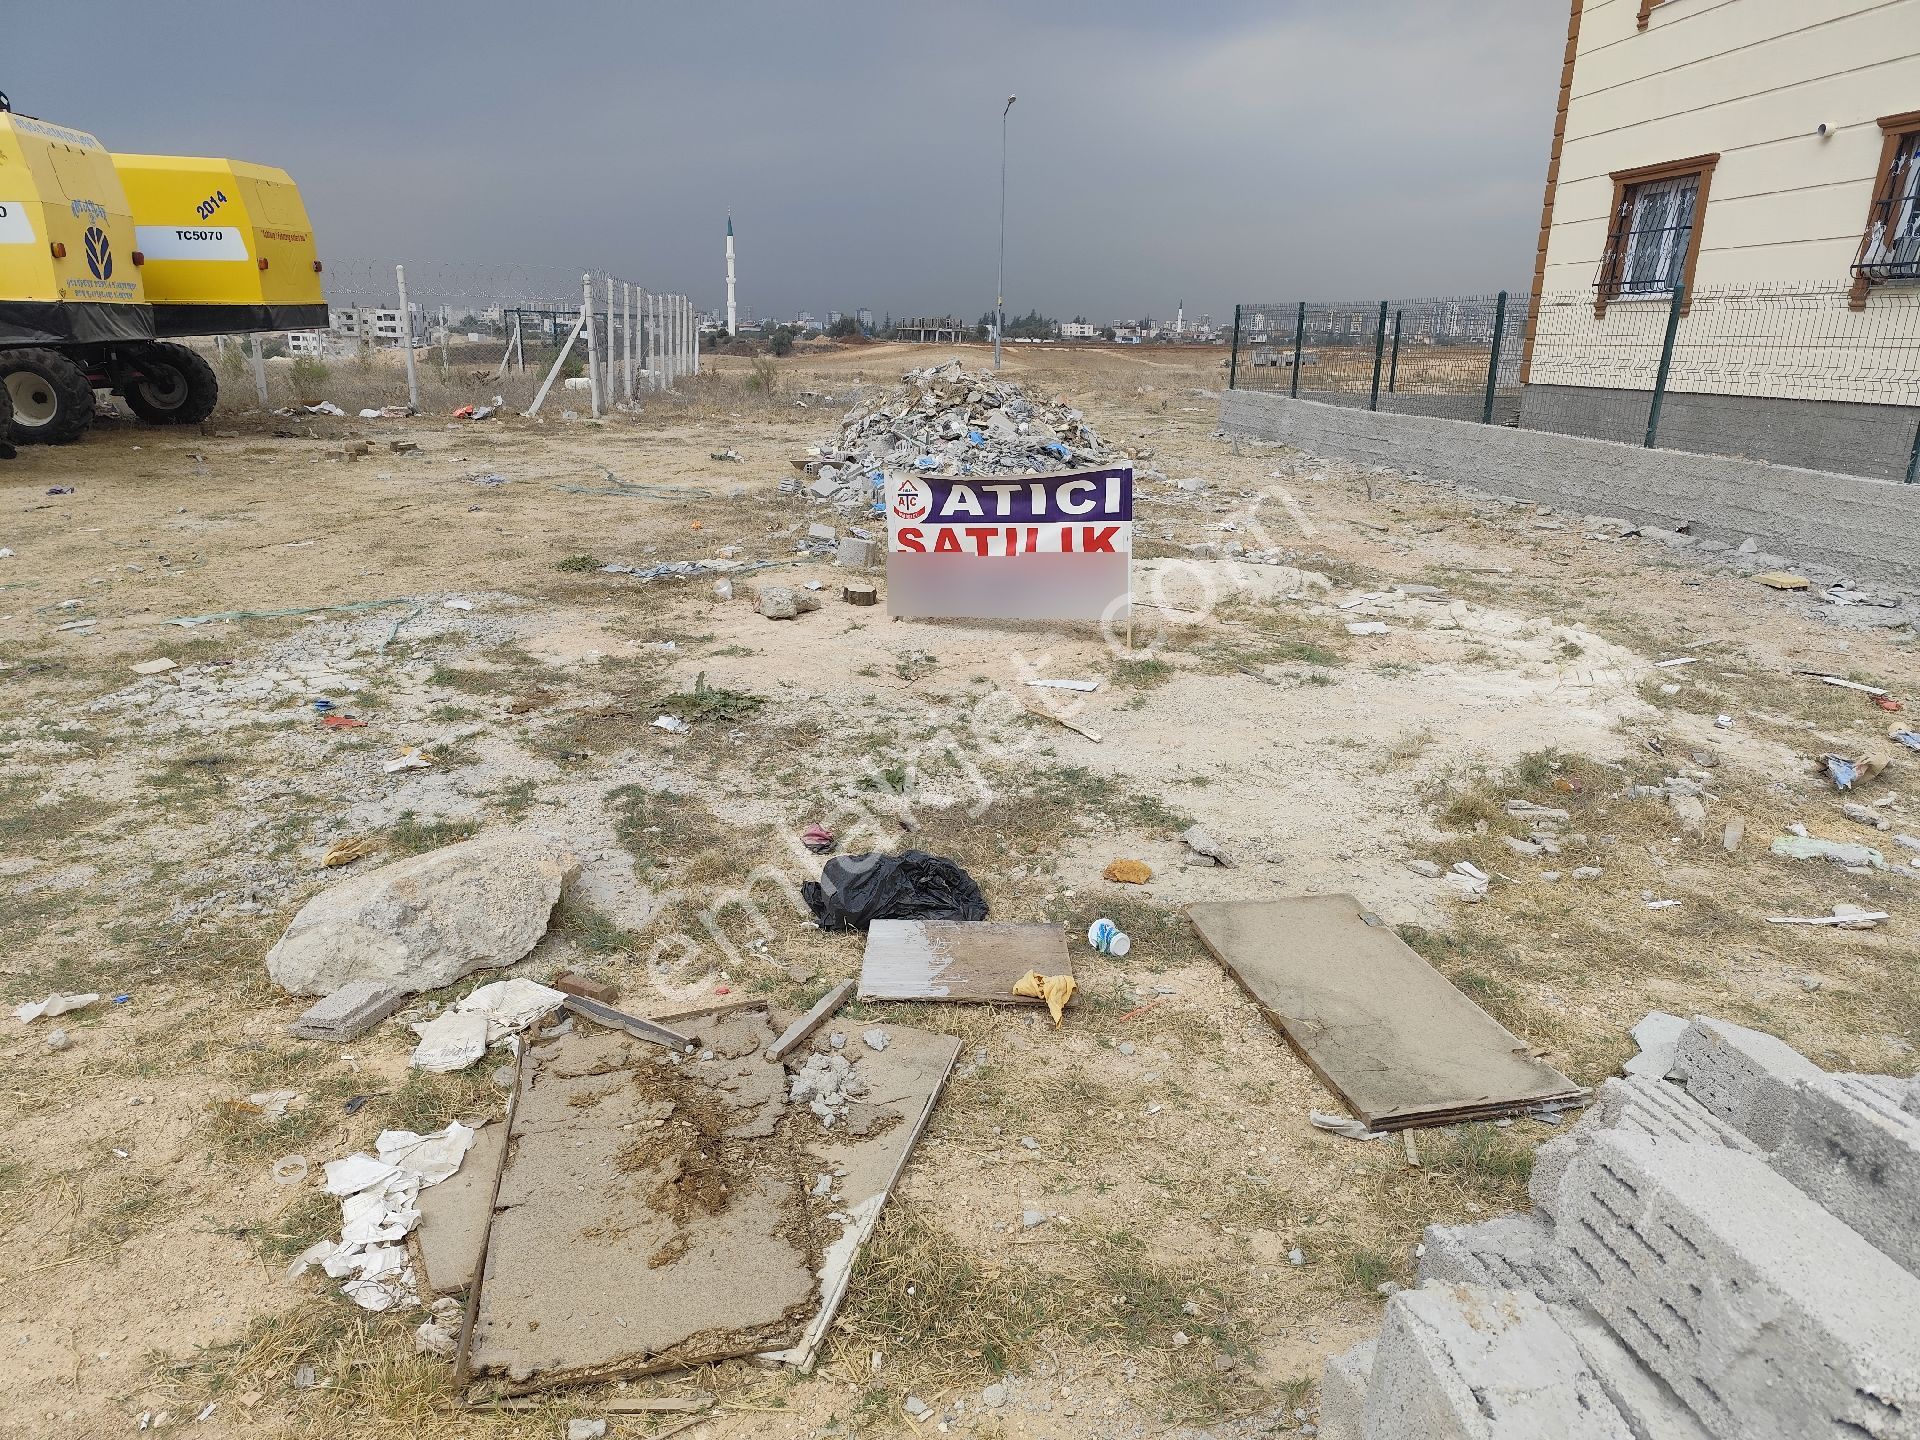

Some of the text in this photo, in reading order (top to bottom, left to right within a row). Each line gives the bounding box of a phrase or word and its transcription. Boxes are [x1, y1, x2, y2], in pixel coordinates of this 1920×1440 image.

[196, 190, 227, 221] 2014
[175, 230, 223, 241] TC5070
[939, 477, 1121, 516] ATICI
